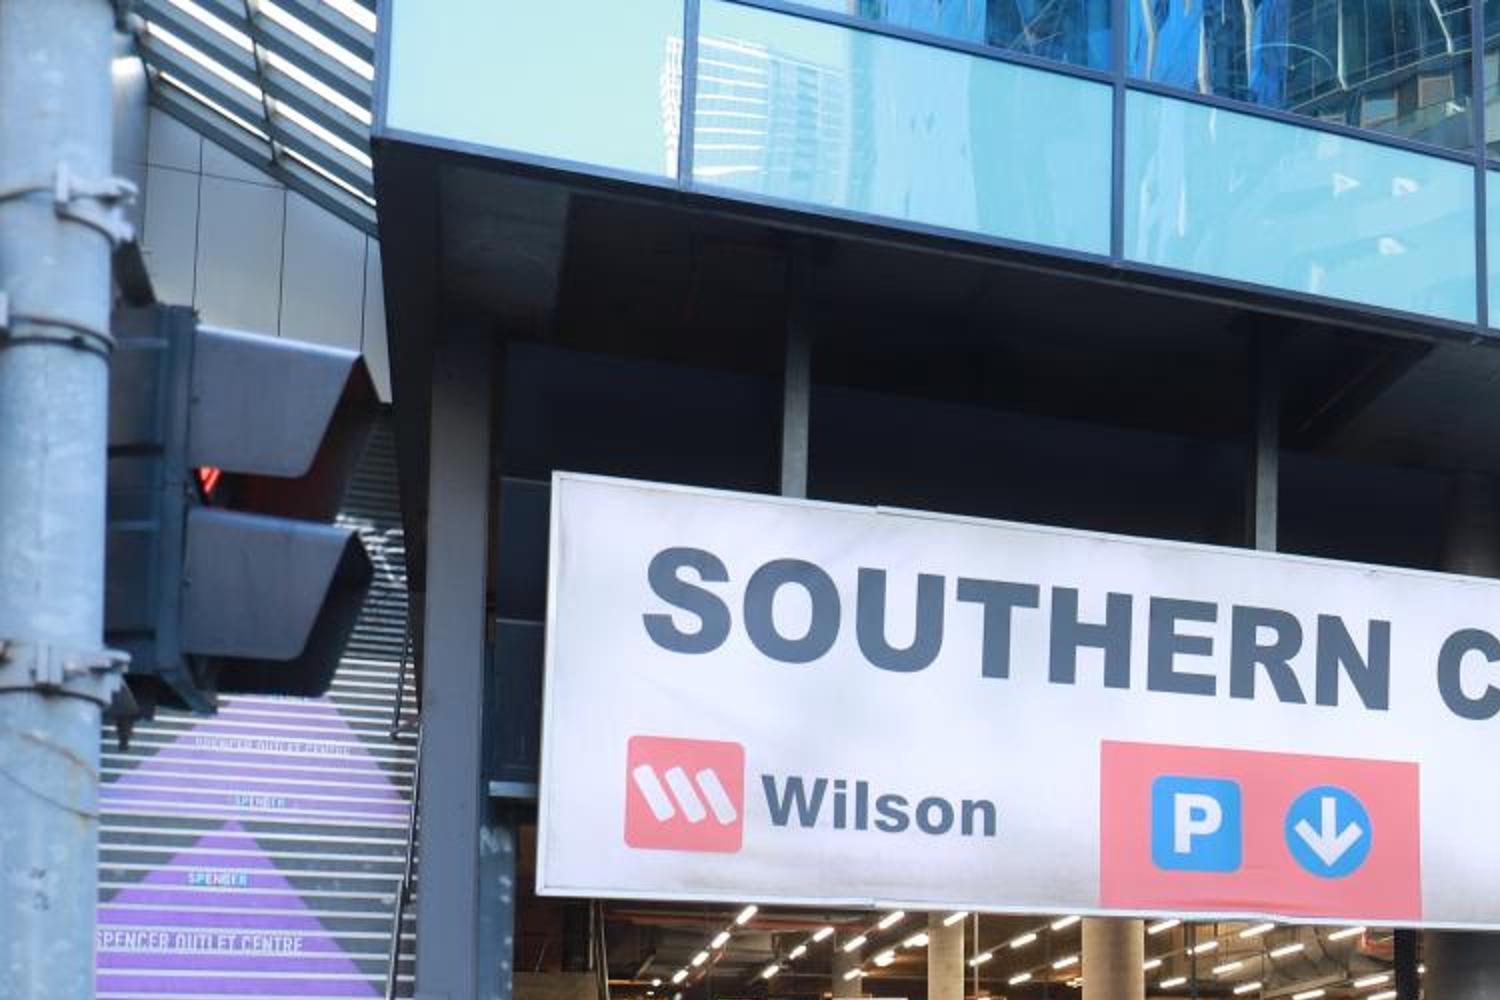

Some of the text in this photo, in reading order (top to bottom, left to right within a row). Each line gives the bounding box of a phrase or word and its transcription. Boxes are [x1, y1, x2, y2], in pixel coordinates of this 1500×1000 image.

[642, 546, 1392, 711] SOUTHERN
[761, 774, 997, 837] Wilson
[1173, 793, 1222, 854] P
[241, 936, 303, 953] CENTRE
